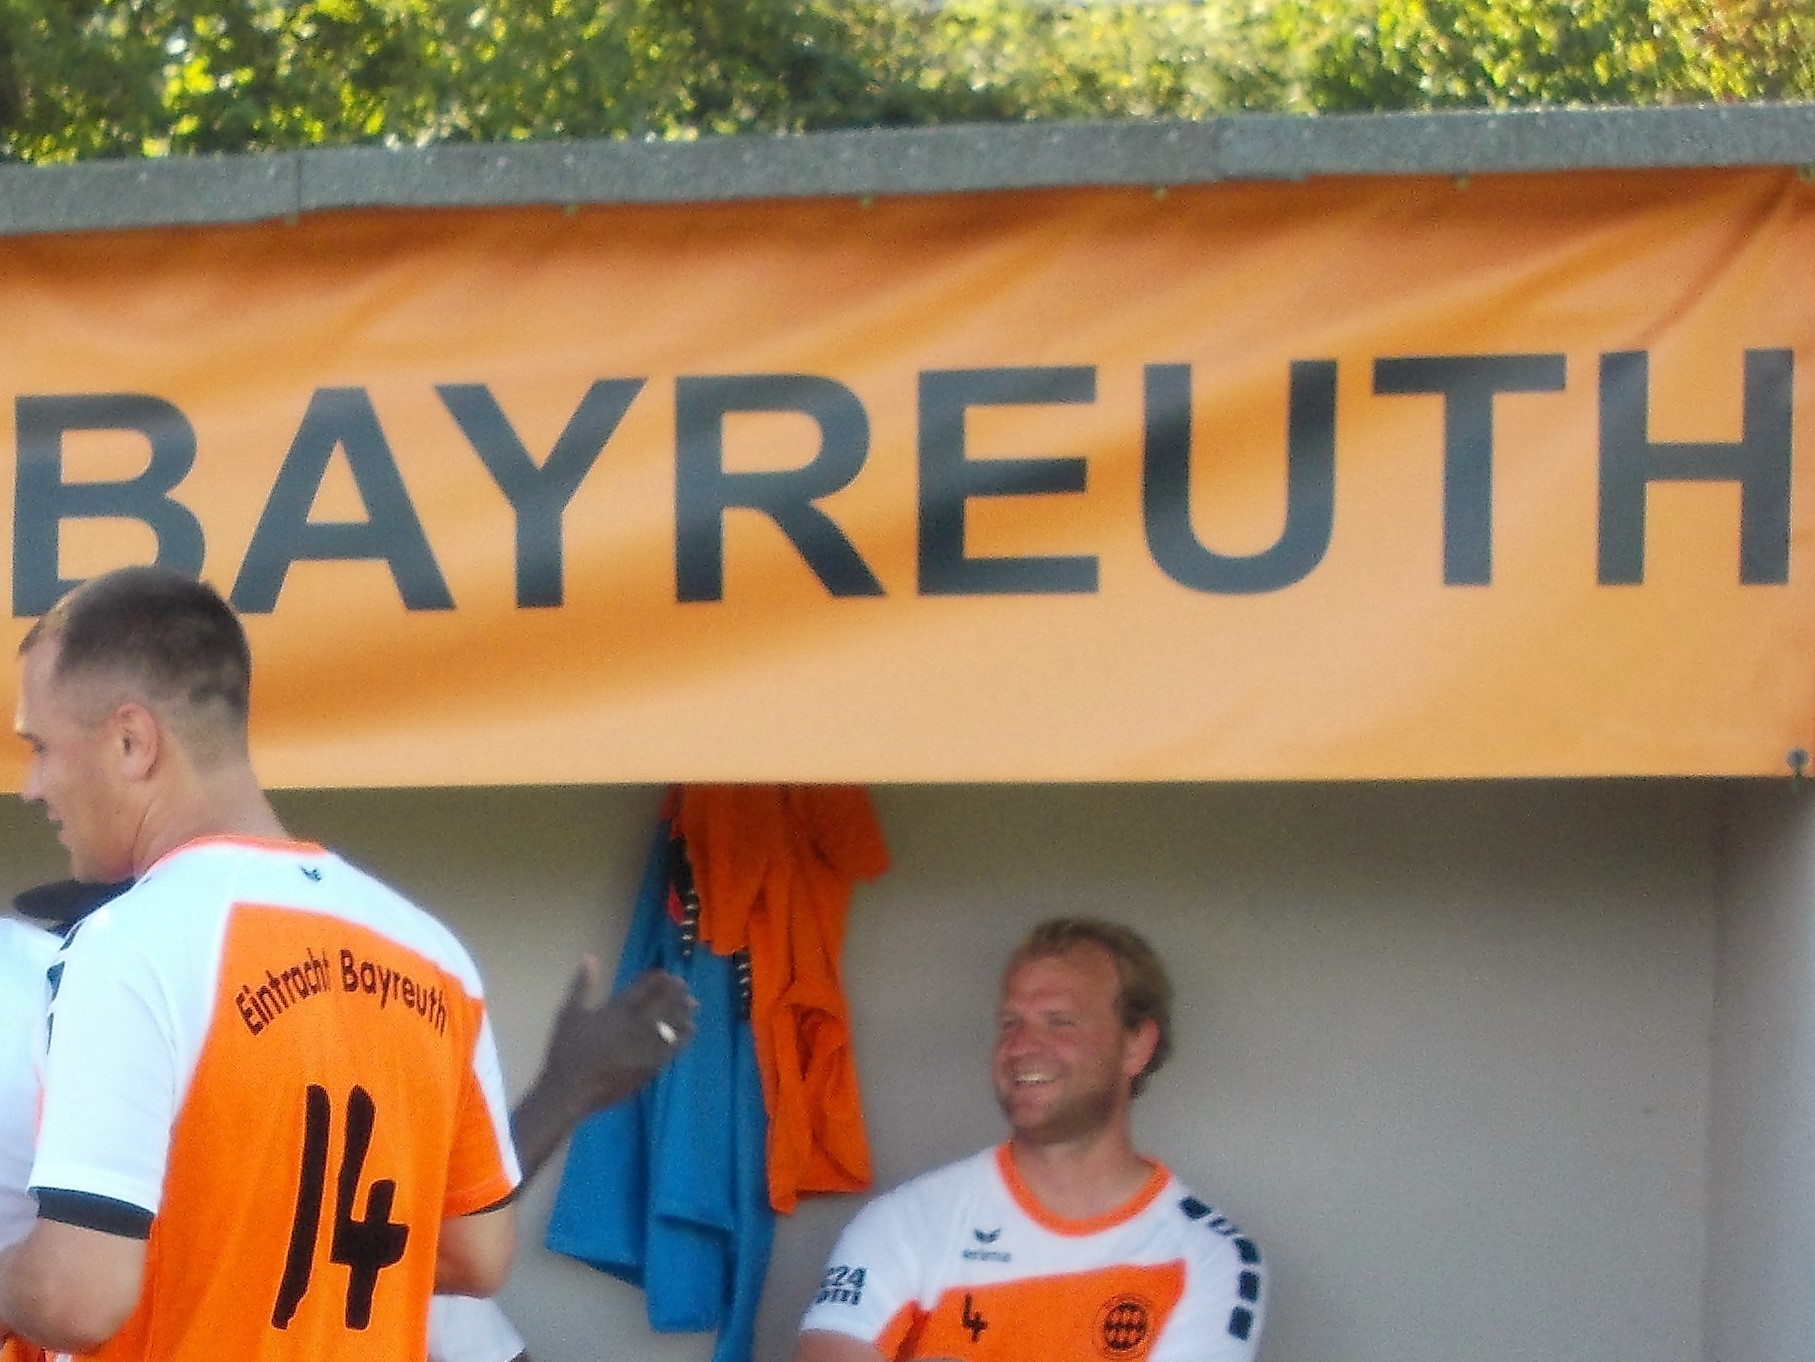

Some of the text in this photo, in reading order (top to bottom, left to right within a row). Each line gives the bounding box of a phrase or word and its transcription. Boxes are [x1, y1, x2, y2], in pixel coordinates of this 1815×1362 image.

[12, 348, 1794, 617] BAYREUTH
[236, 948, 447, 1037] Eintracht Bayreuth
[271, 1084, 410, 1331] 14
[962, 1294, 988, 1342] 4
